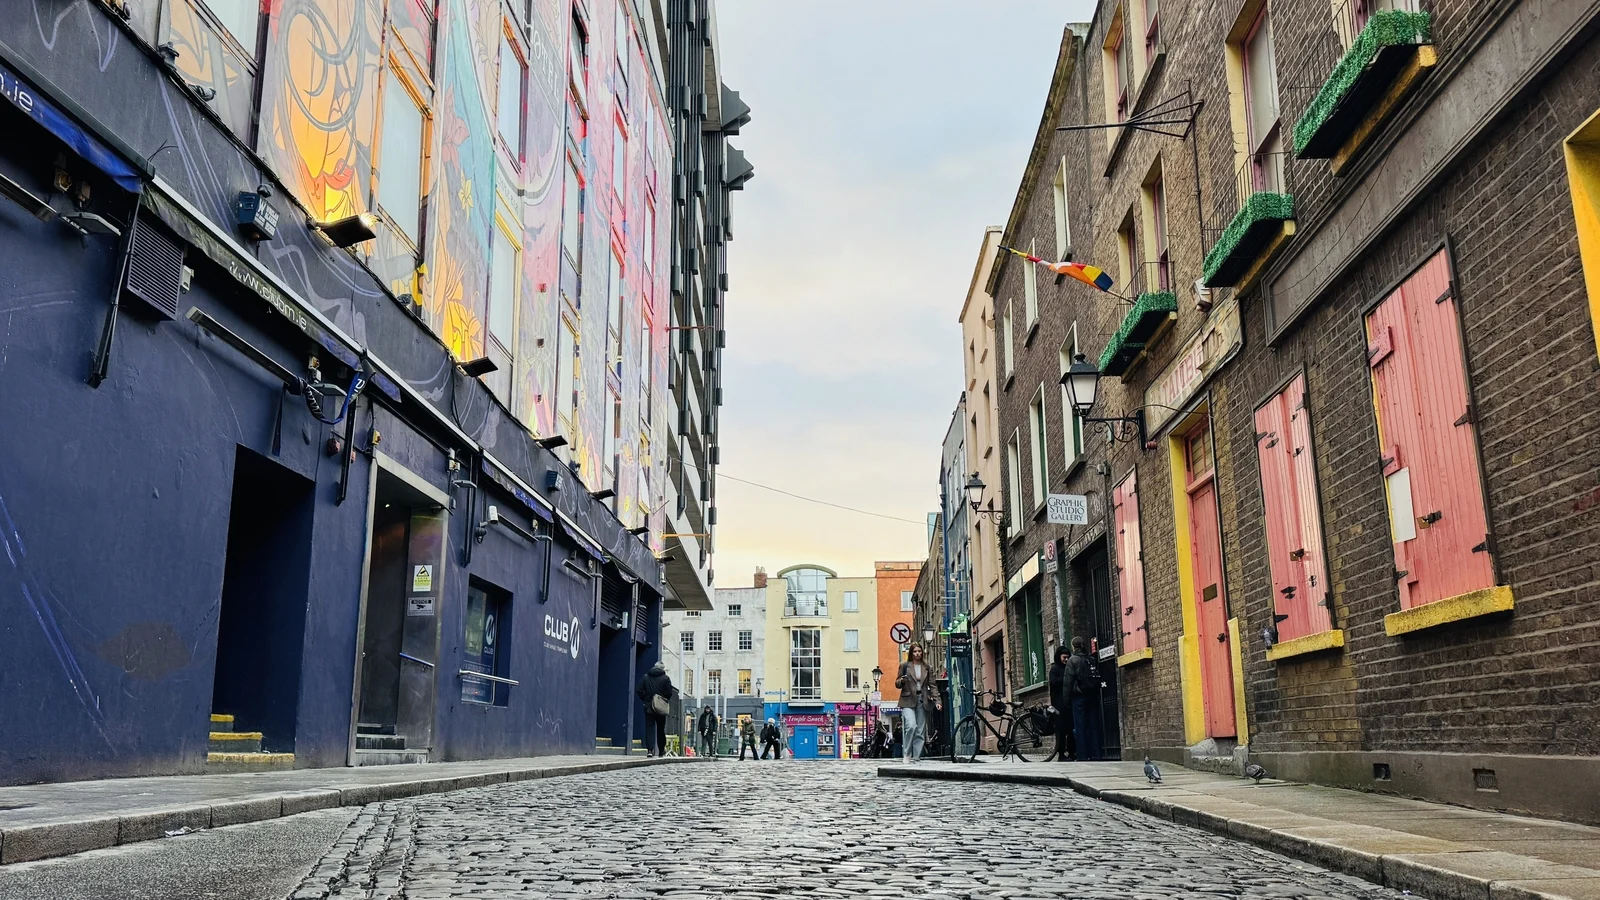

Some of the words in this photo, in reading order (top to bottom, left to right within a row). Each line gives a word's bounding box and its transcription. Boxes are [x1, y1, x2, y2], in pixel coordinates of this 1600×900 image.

[1047, 496, 1086, 508] GRAPHIC
[1049, 505, 1085, 515] STUDIO
[1050, 512, 1084, 522] GALLERY
[544, 614, 569, 643] CLUB
[788, 715, 807, 723] Temple
